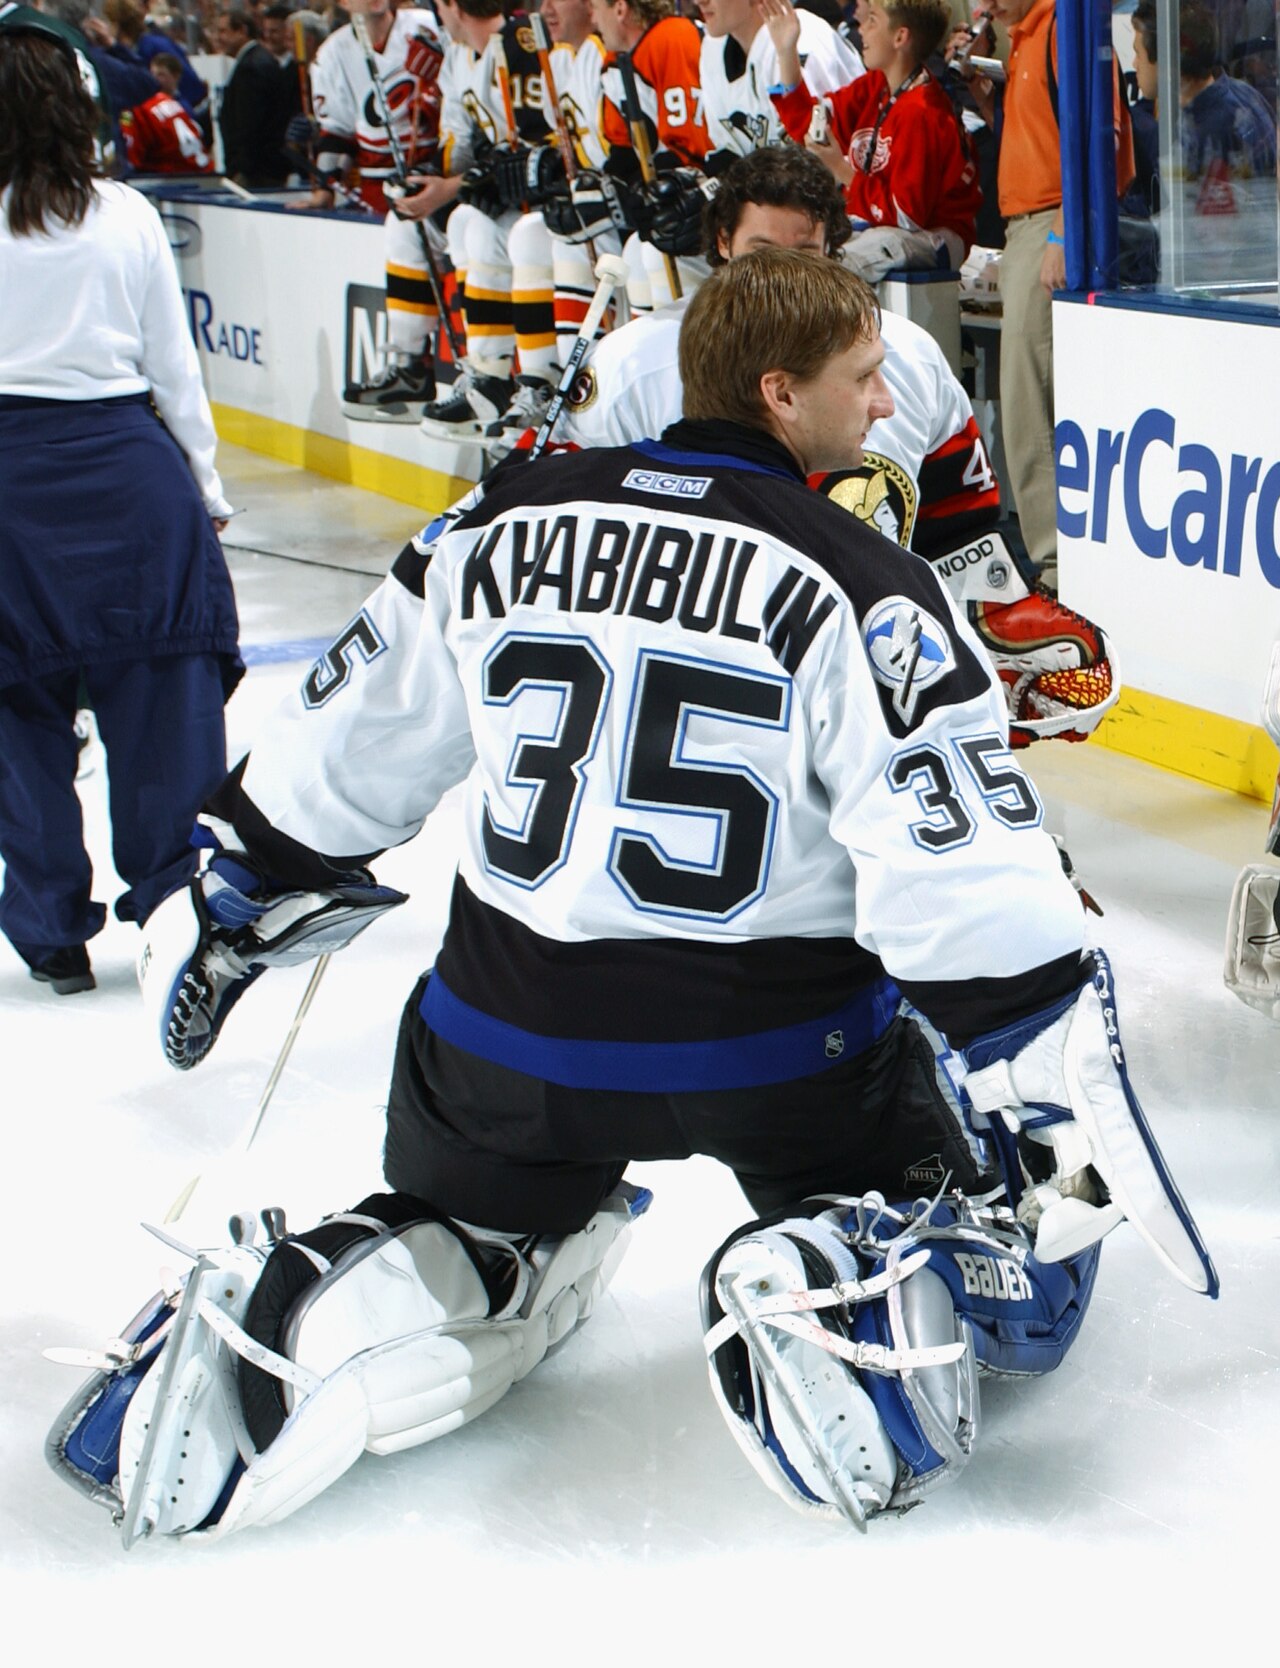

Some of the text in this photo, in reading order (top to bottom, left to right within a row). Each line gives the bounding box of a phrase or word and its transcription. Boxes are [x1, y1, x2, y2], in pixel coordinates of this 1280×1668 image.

[182, 287, 264, 365] RADE
[626, 471, 708, 496] CCM
[460, 513, 839, 678] KHABIBULIN
[482, 631, 794, 925] 35
[885, 731, 1045, 855] 35
[910, 1169, 939, 1181] NHL
